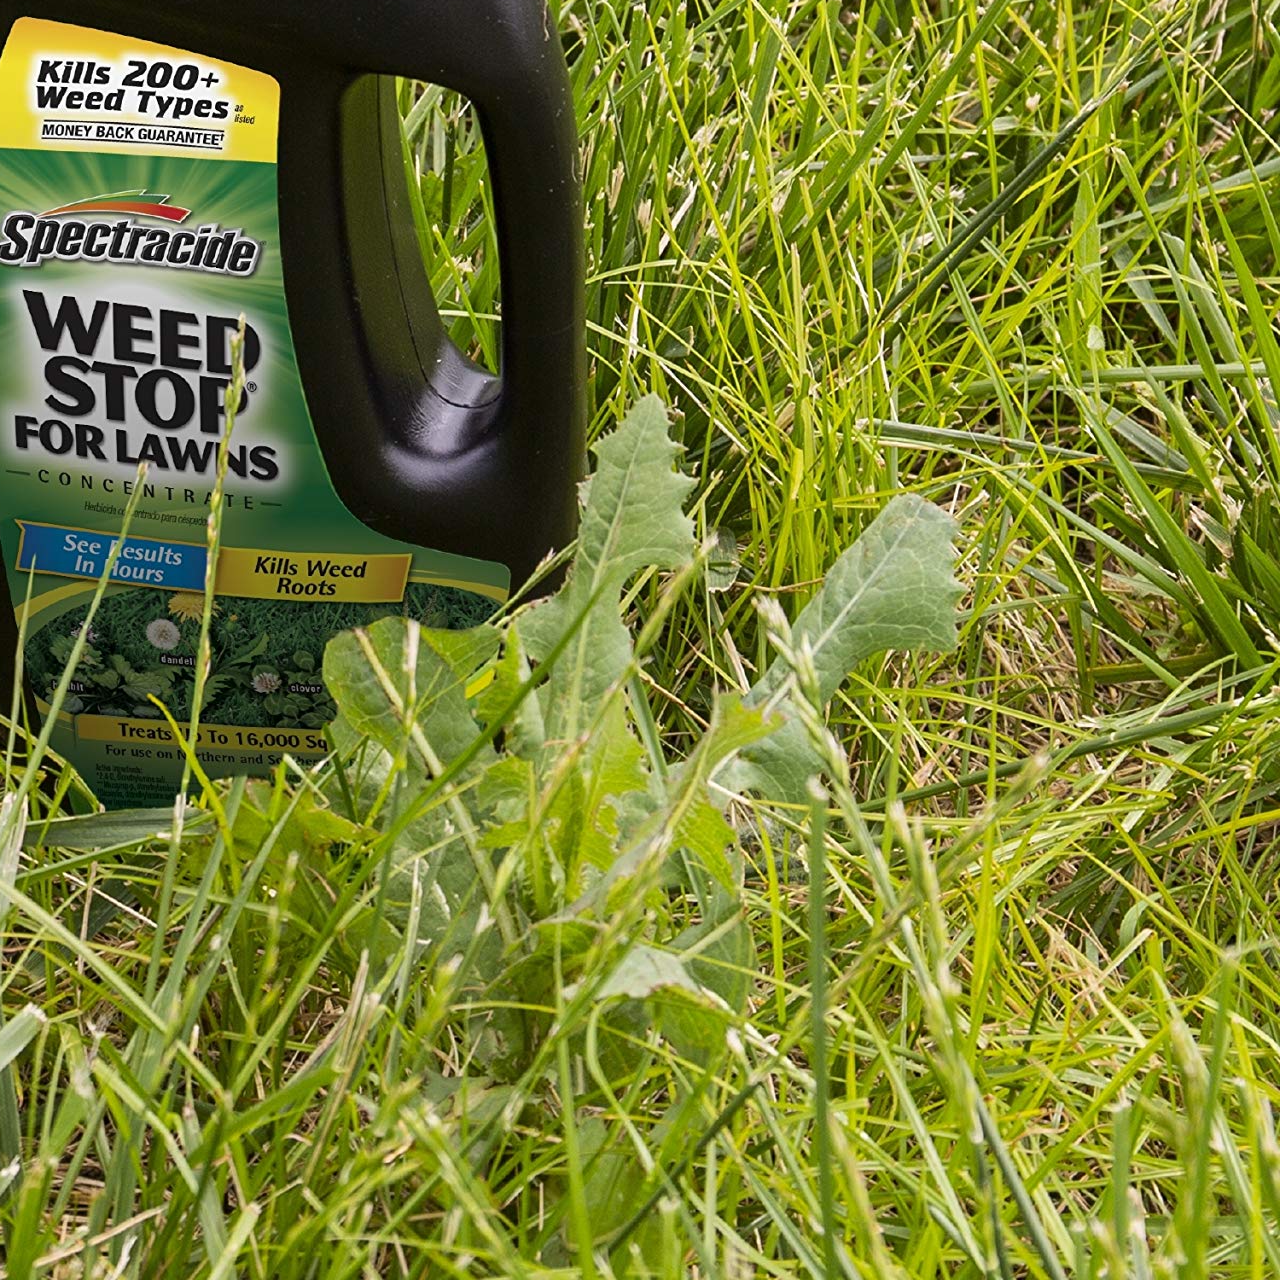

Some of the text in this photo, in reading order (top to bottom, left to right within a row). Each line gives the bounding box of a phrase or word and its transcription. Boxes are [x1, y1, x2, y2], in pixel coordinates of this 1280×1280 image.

[37, 60, 220, 91] Kills 200+
[35, 85, 229, 120] Weed Types
[41, 123, 93, 138] MONEY
[95, 126, 135, 141] BACK
[22, 289, 261, 375] WEED
[14, 414, 279, 481] FOR LAWNS
[37, 469, 255, 510] CONCENTRATE
[63, 533, 102, 554] See
[75, 555, 95, 574] In
[254, 556, 368, 578] Kills Weed
[276, 577, 337, 596] Roots
[290, 683, 321, 693] clover
[118, 722, 173, 741] Treats
[206, 729, 229, 745] To
[235, 732, 300, 749] 16,000
[105, 744, 126, 756] For
[131, 748, 152, 759] use
[156, 750, 173, 760] on
[177, 749, 235, 763] Nrthern
[240, 753, 263, 765] and
